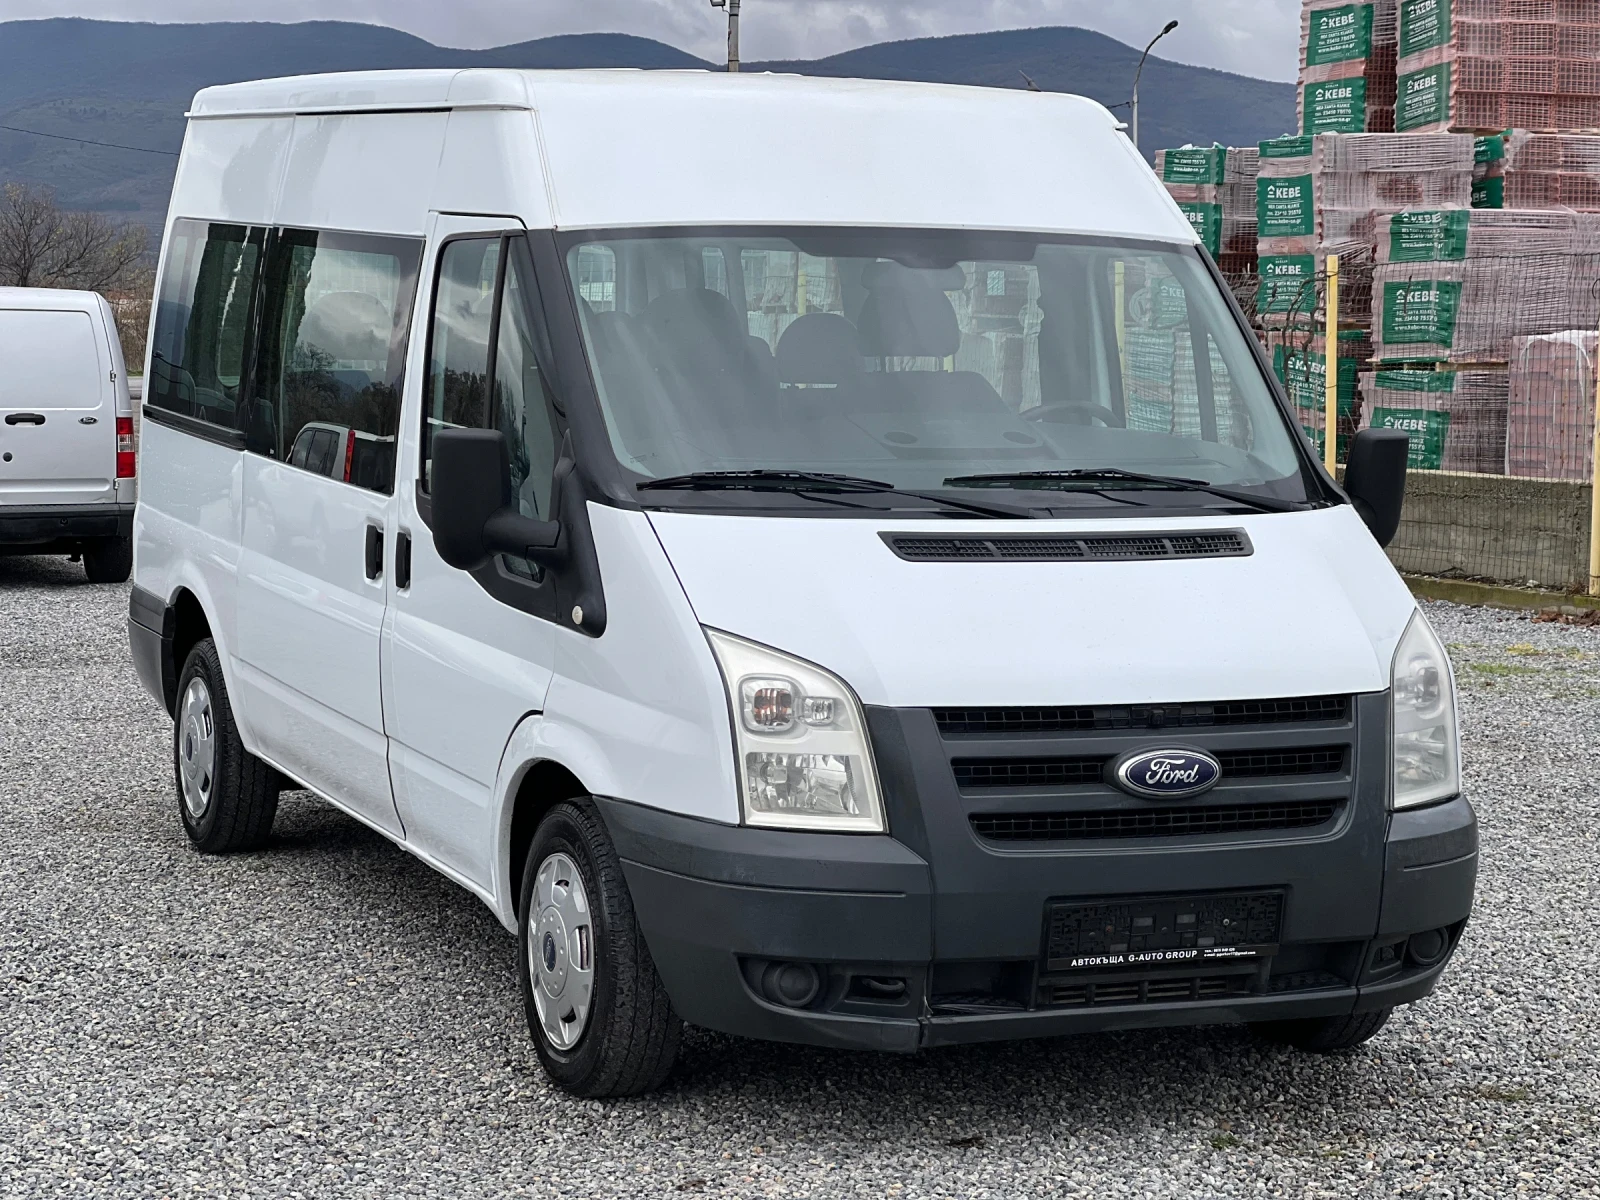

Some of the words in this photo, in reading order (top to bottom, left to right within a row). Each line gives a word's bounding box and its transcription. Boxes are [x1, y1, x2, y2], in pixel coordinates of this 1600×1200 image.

[1328, 12, 1354, 28] KEBE
[1413, 74, 1437, 92] KEBE
[1325, 87, 1352, 100] KEBE
[1276, 186, 1301, 198] KEBE
[1275, 264, 1302, 275] KEBE
[1406, 290, 1440, 303] KEBE
[1394, 419, 1428, 432] KEBE
[1145, 758, 1200, 785] Ford
[1070, 955, 1124, 967] АВТОКЪЩА
[1128, 952, 1163, 962] G-AUTO
[1165, 950, 1198, 959] GROUP
